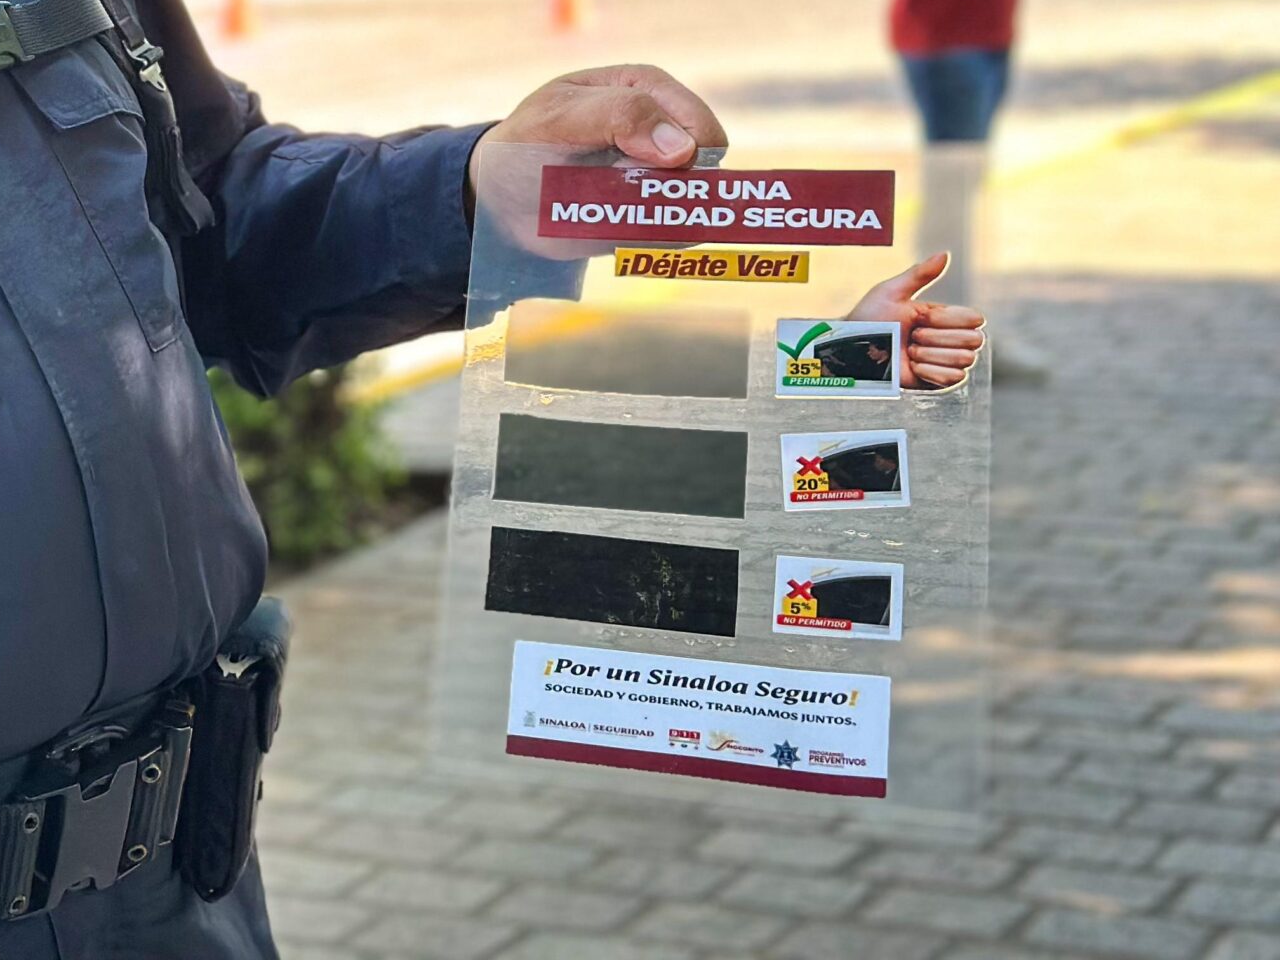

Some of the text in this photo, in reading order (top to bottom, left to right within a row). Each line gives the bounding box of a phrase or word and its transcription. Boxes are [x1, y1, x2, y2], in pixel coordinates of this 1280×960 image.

[641, 179, 792, 201] POR UNA
[551, 202, 883, 229] MOVILIDAD SEGURA
[620, 253, 799, 279] ¡Déjate Ver!
[789, 362, 821, 375] 35%
[789, 377, 849, 386] PERMITIDO
[796, 477, 828, 491] 20%
[811, 491, 860, 500] PERMITIDO
[790, 601, 812, 615] 5%
[783, 616, 848, 629] NO PERMITIDO
[544, 658, 860, 707] ¡Por un Sinaloa Seguro!
[544, 683, 857, 727] SOCIEDAD Y GOBIERNO, TRABAJAMOS JUNTOS.
[539, 718, 586, 730] SINALOA
[593, 724, 655, 738] SEGURIDAD
[809, 755, 867, 767] PREVENTIVOS
